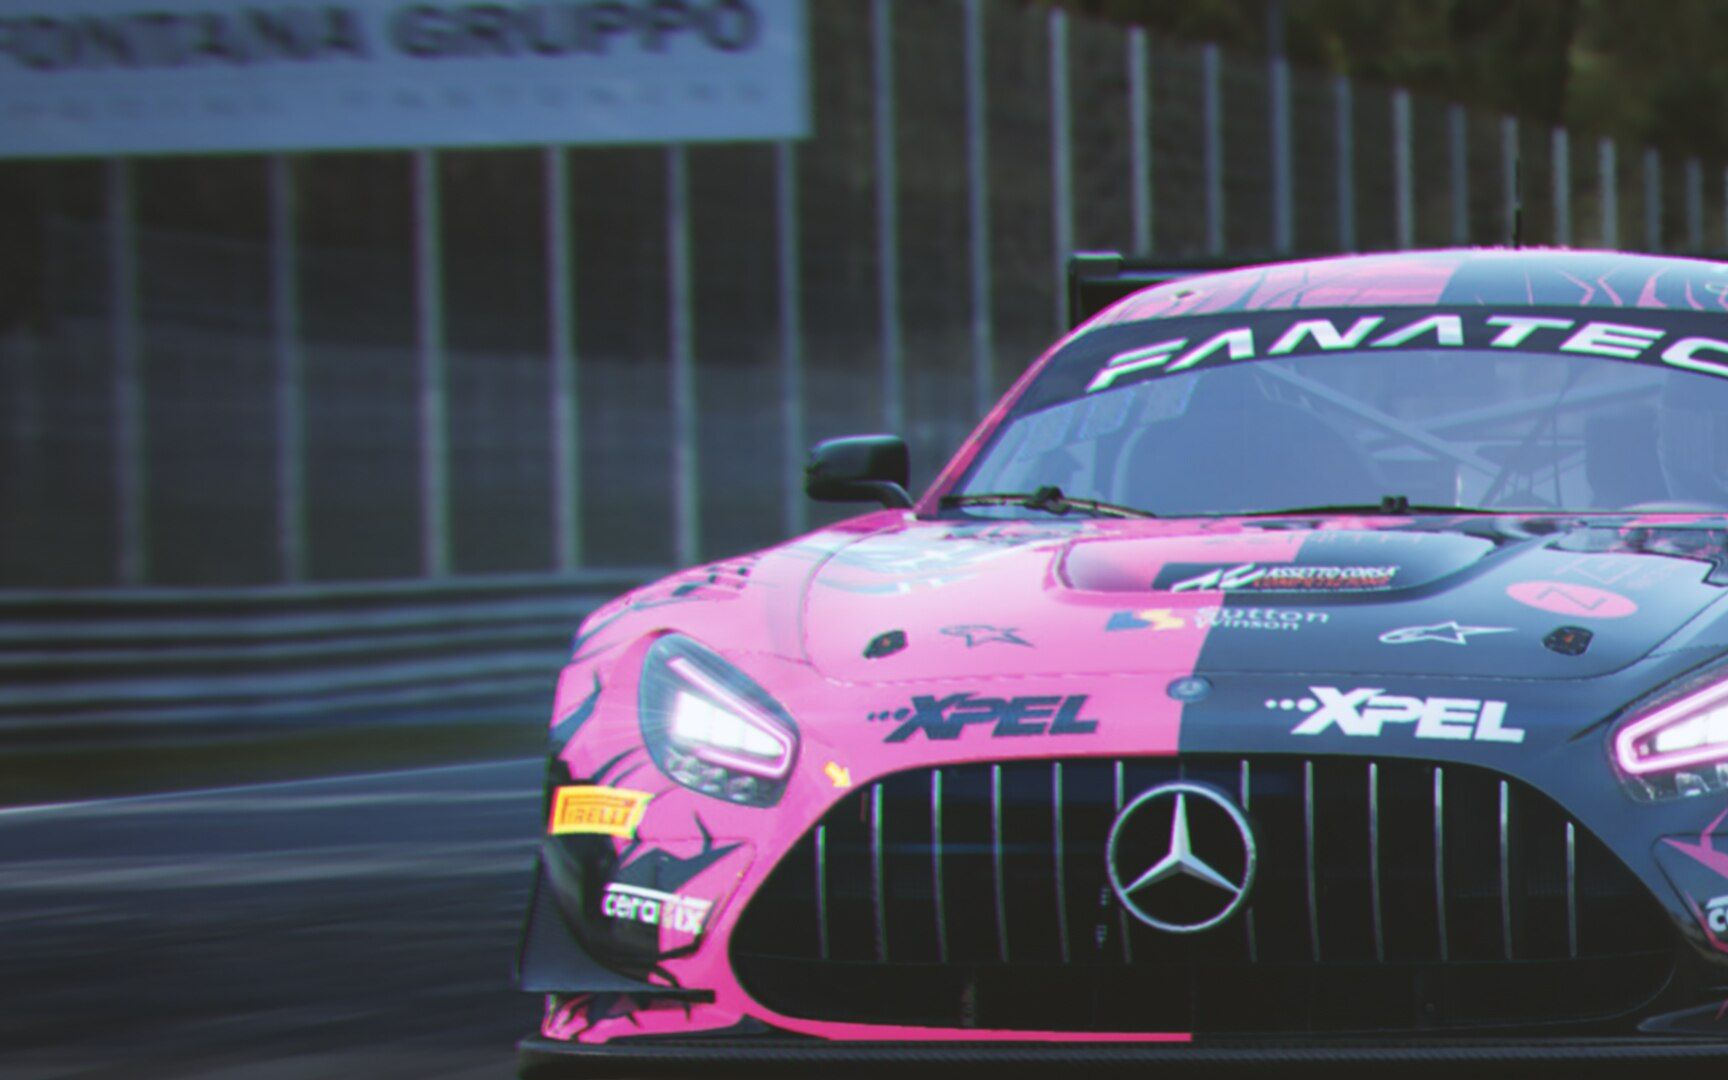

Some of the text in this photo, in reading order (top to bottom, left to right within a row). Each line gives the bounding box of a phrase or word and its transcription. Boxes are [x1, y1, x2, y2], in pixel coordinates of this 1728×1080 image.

[385, 0, 764, 58] GRUPPO
[1266, 565, 1397, 579] ASSETTO CORSA
[883, 692, 1098, 743] XPEL
[1290, 685, 1525, 743] XPEL
